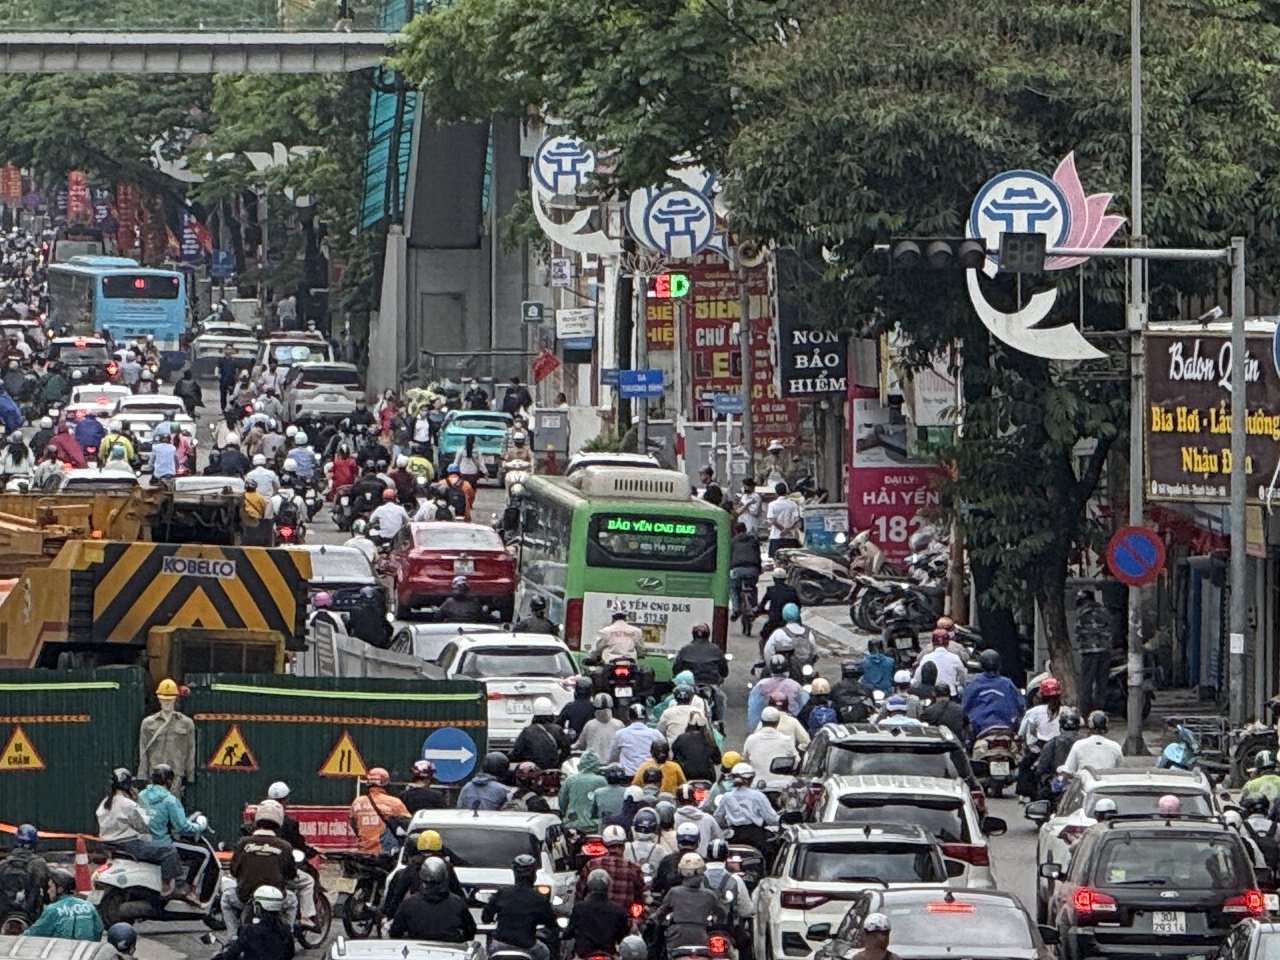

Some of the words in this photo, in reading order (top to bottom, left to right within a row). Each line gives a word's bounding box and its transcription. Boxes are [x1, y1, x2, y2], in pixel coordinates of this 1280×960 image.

[795, 347, 840, 369] BẢO
[1169, 339, 1215, 381] Balon
[789, 369, 848, 393] HIỂM
[1151, 406, 1173, 432] Bia
[1181, 446, 1219, 480] Nhậu
[884, 475, 902, 487] ĐẠI
[863, 487, 896, 505] HẢI
[901, 485, 940, 505] YẾN
[163, 557, 235, 577] KOBELCO
[672, 603, 691, 613] BUS
